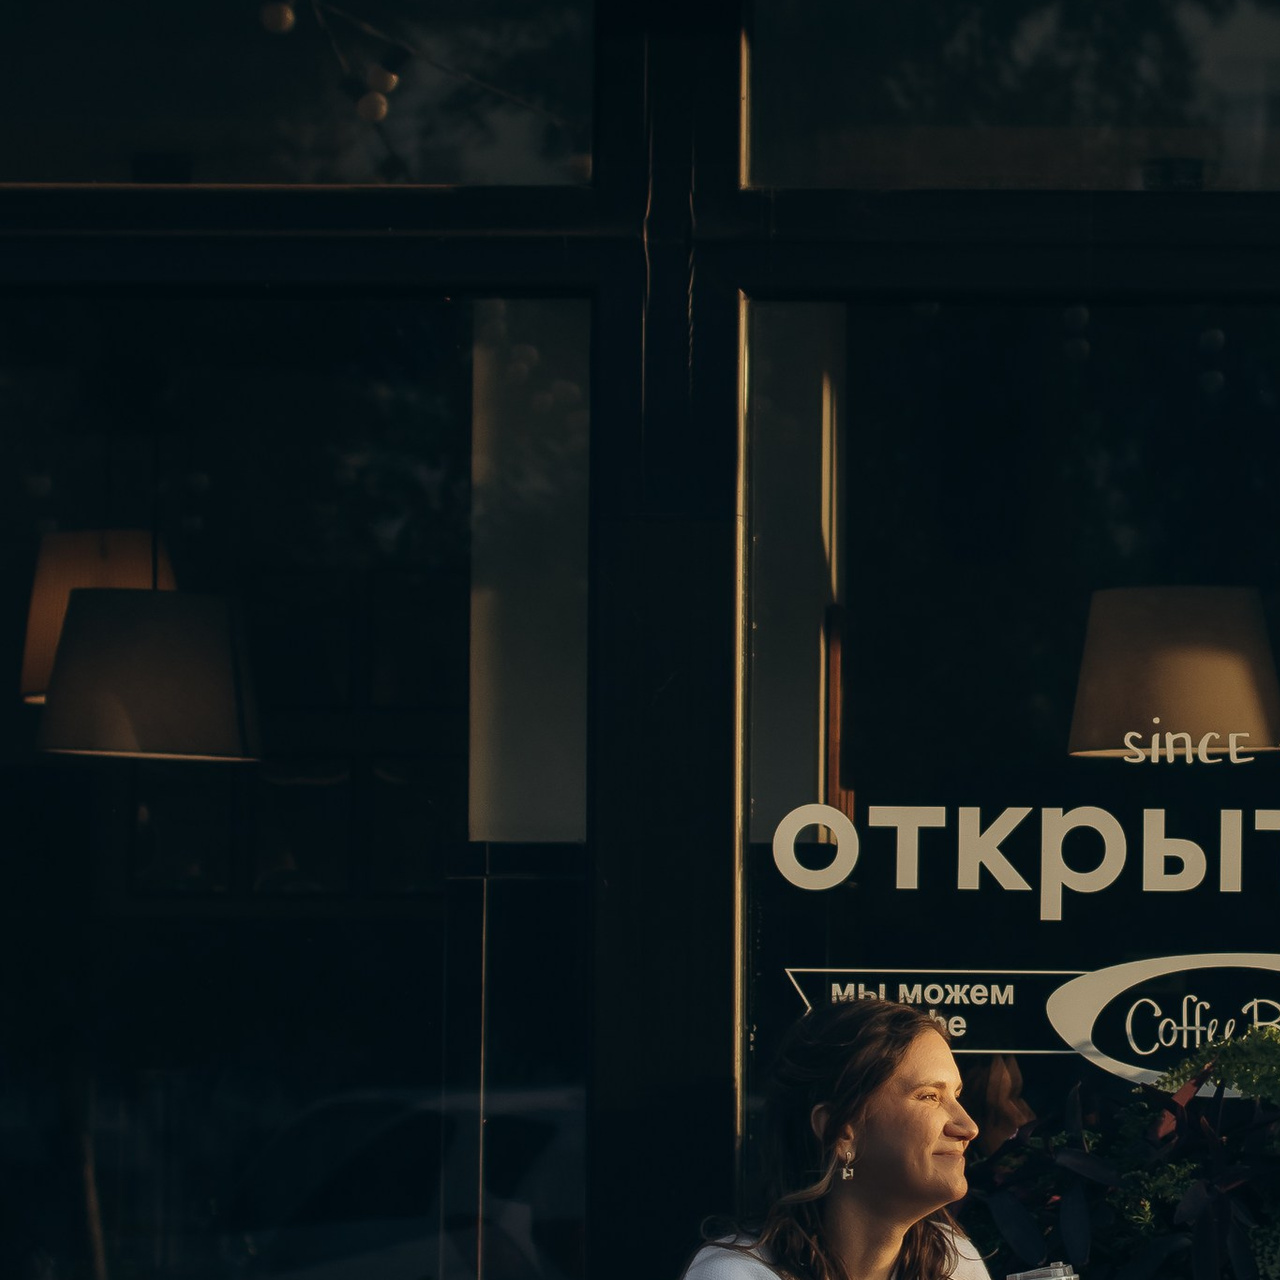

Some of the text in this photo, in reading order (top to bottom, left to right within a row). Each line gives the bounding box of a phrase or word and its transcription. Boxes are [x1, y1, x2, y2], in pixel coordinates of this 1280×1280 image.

[831, 982, 1015, 1006] мы можем
[1125, 995, 1235, 1056] Coffee
